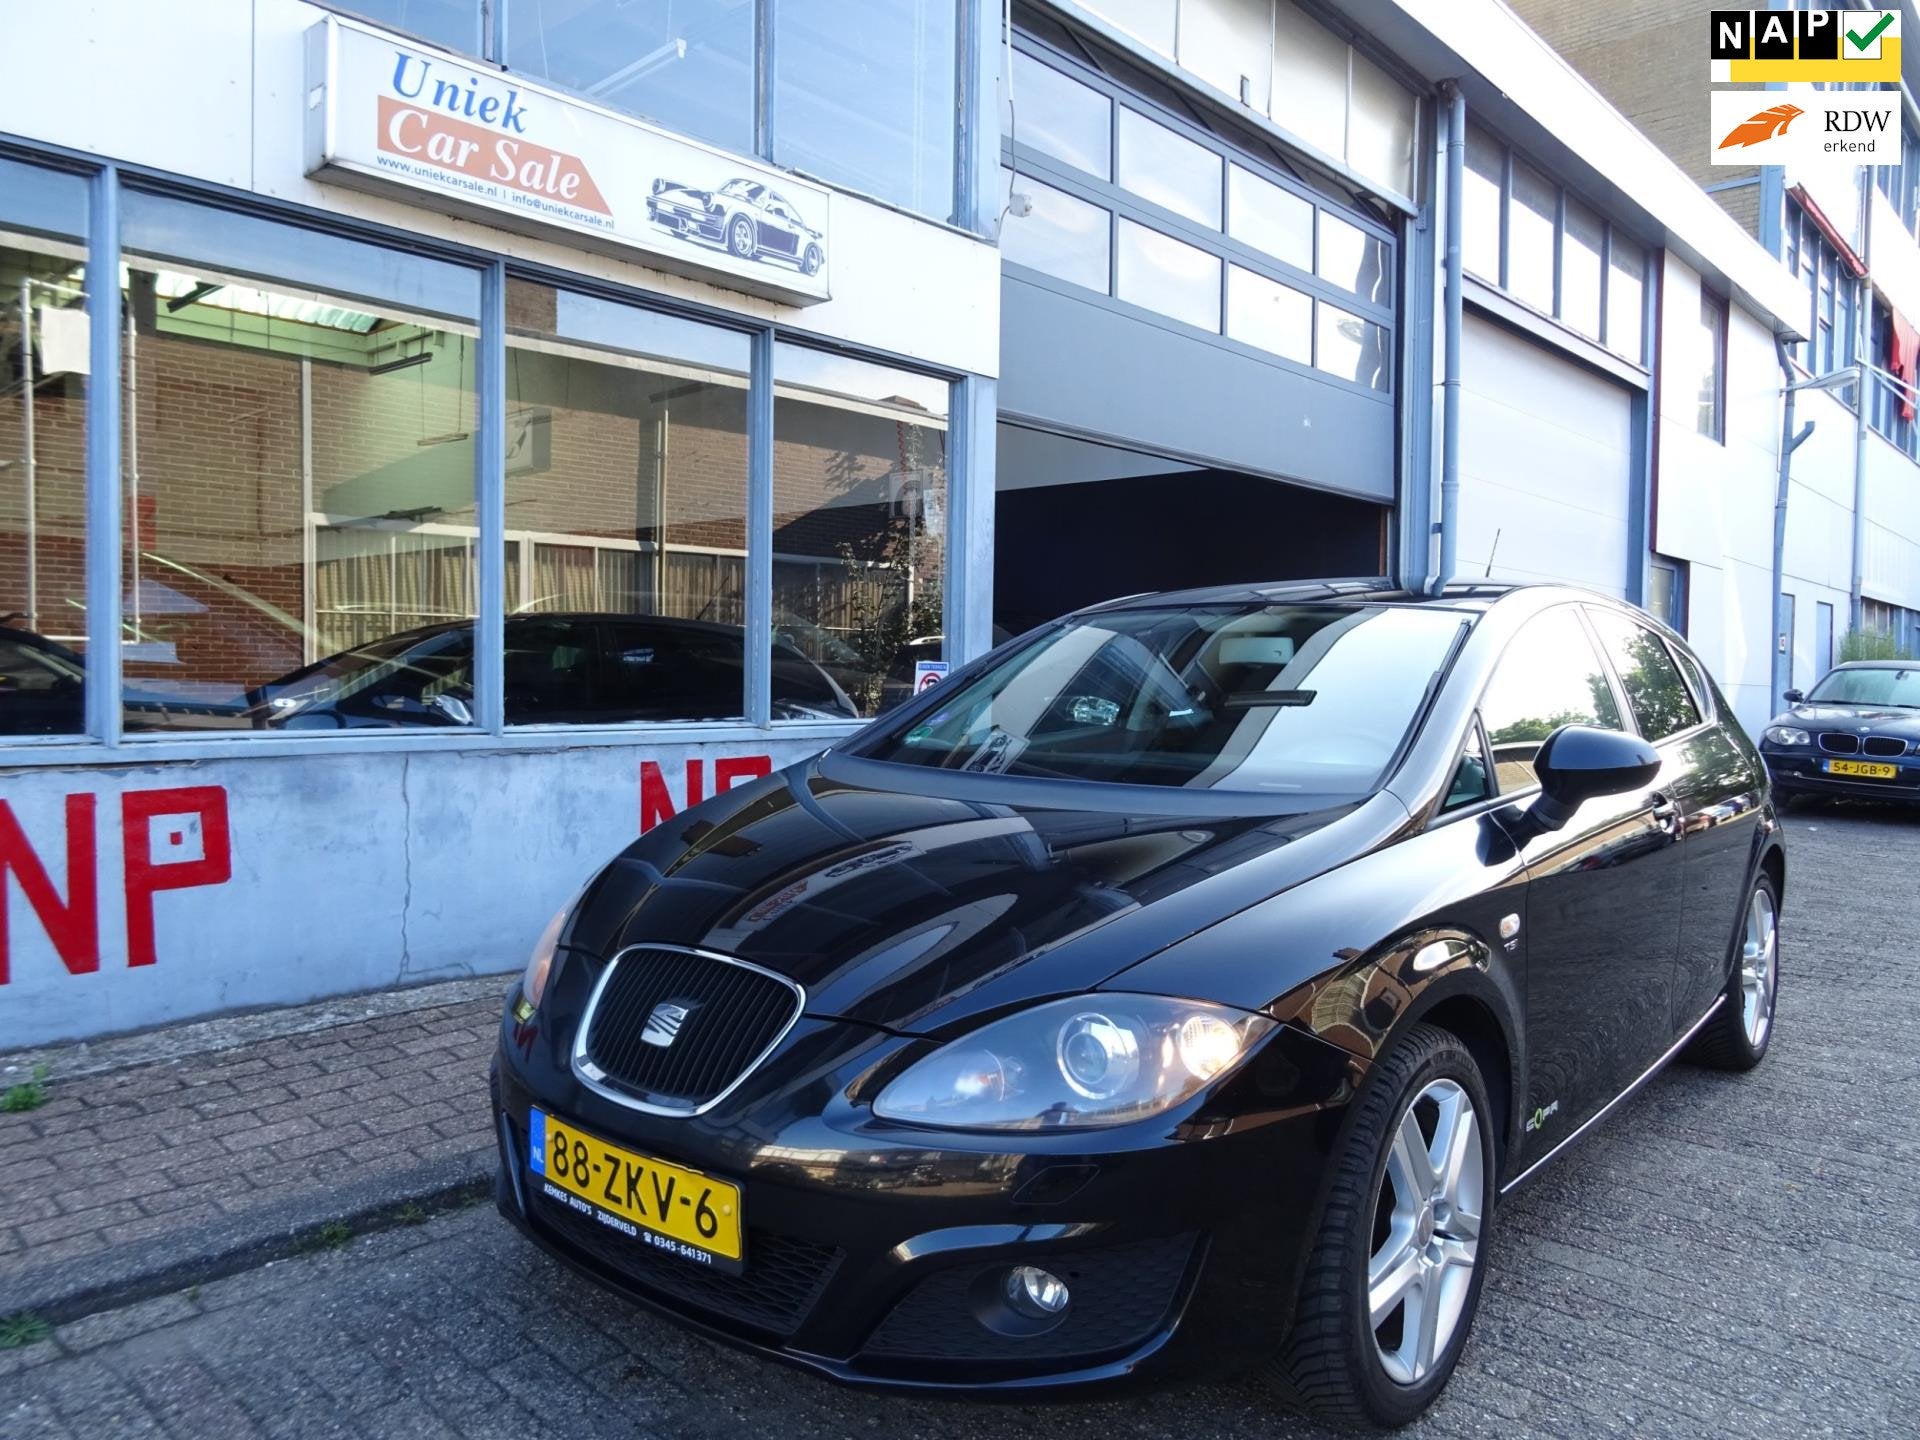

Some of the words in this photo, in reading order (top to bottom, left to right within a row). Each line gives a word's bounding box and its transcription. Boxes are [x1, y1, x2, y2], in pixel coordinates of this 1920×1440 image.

[392, 51, 527, 134] Uniek
[376, 155, 498, 198] www.uniekcarsale.nl
[511, 191, 615, 230] info@uniekcarsale.nl
[388, 108, 479, 169] Car
[490, 137, 581, 200] Sale
[1833, 761, 1890, 776] 54-JGB-9
[552, 1130, 718, 1239] 88-ZKV-6
[568, 1196, 593, 1216] AUTO'S
[653, 1235, 713, 1265] 0345-641371
